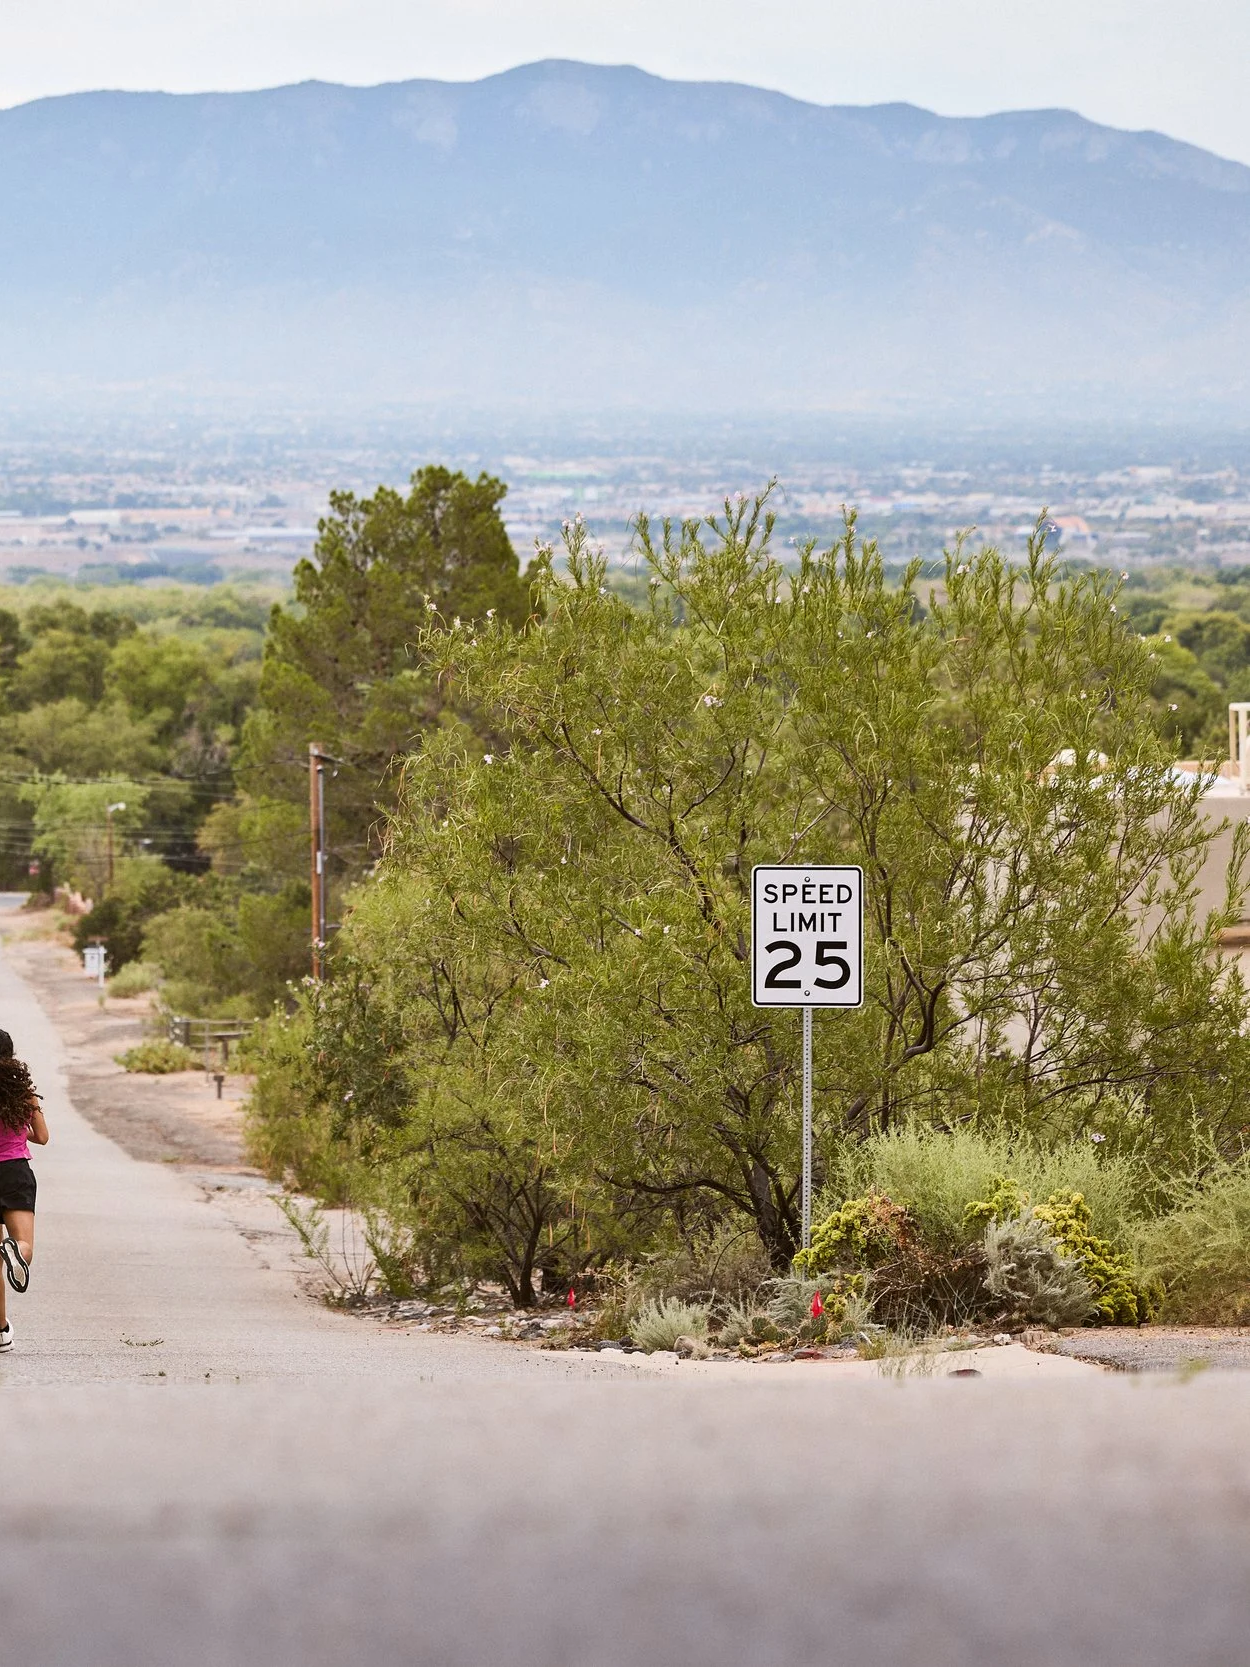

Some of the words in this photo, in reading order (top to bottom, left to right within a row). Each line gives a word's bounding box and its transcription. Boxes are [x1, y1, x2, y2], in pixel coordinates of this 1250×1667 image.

[763, 884, 852, 904] SPEED
[773, 912, 842, 932] LIMIT
[764, 940, 851, 990] 25
